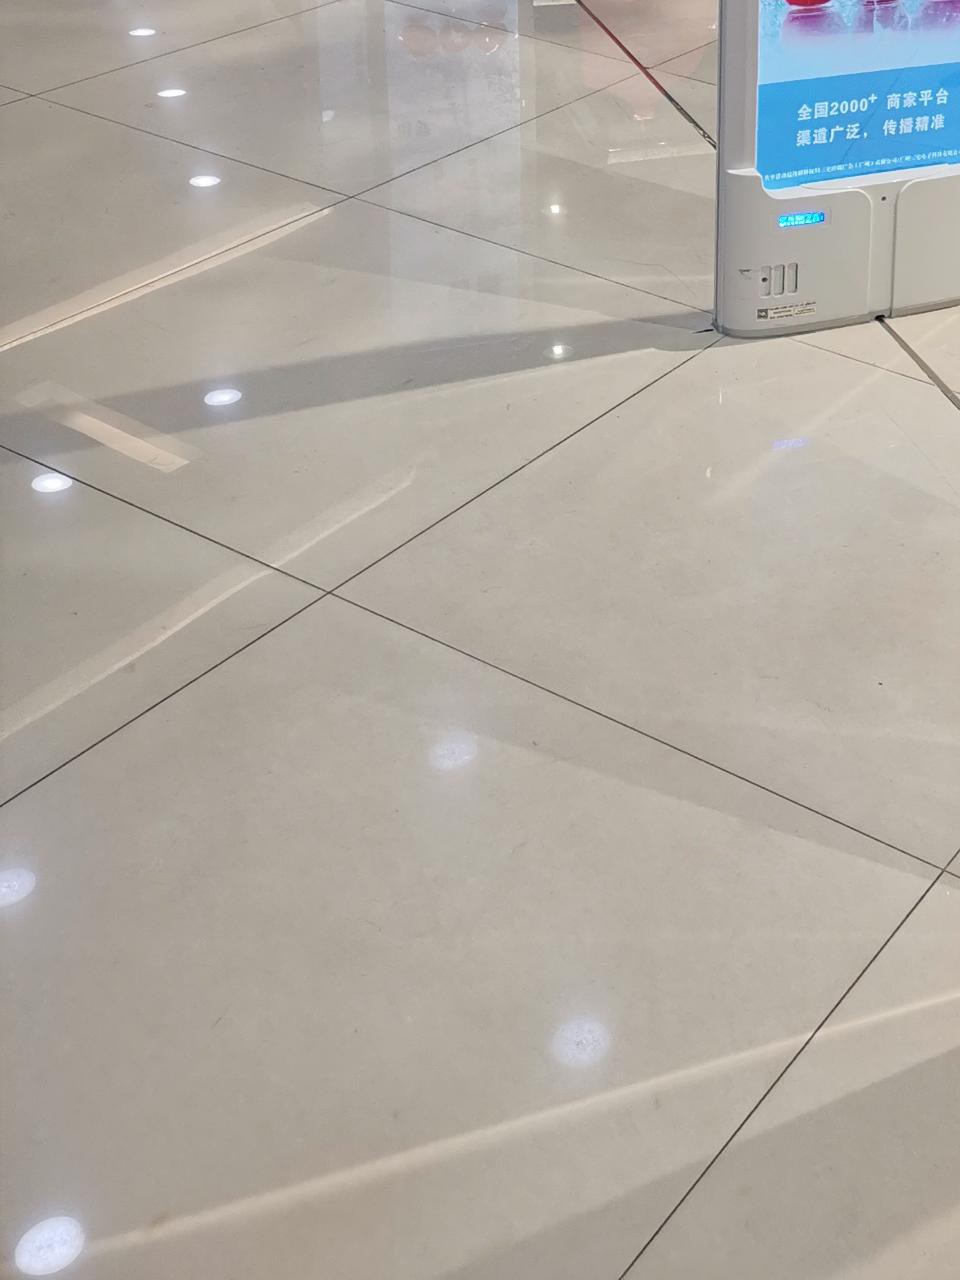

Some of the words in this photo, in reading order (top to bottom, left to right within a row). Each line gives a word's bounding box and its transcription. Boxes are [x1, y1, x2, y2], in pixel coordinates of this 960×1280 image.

[886, 87, 950, 110] 商家平台
[882, 113, 946, 137] 传播精准
